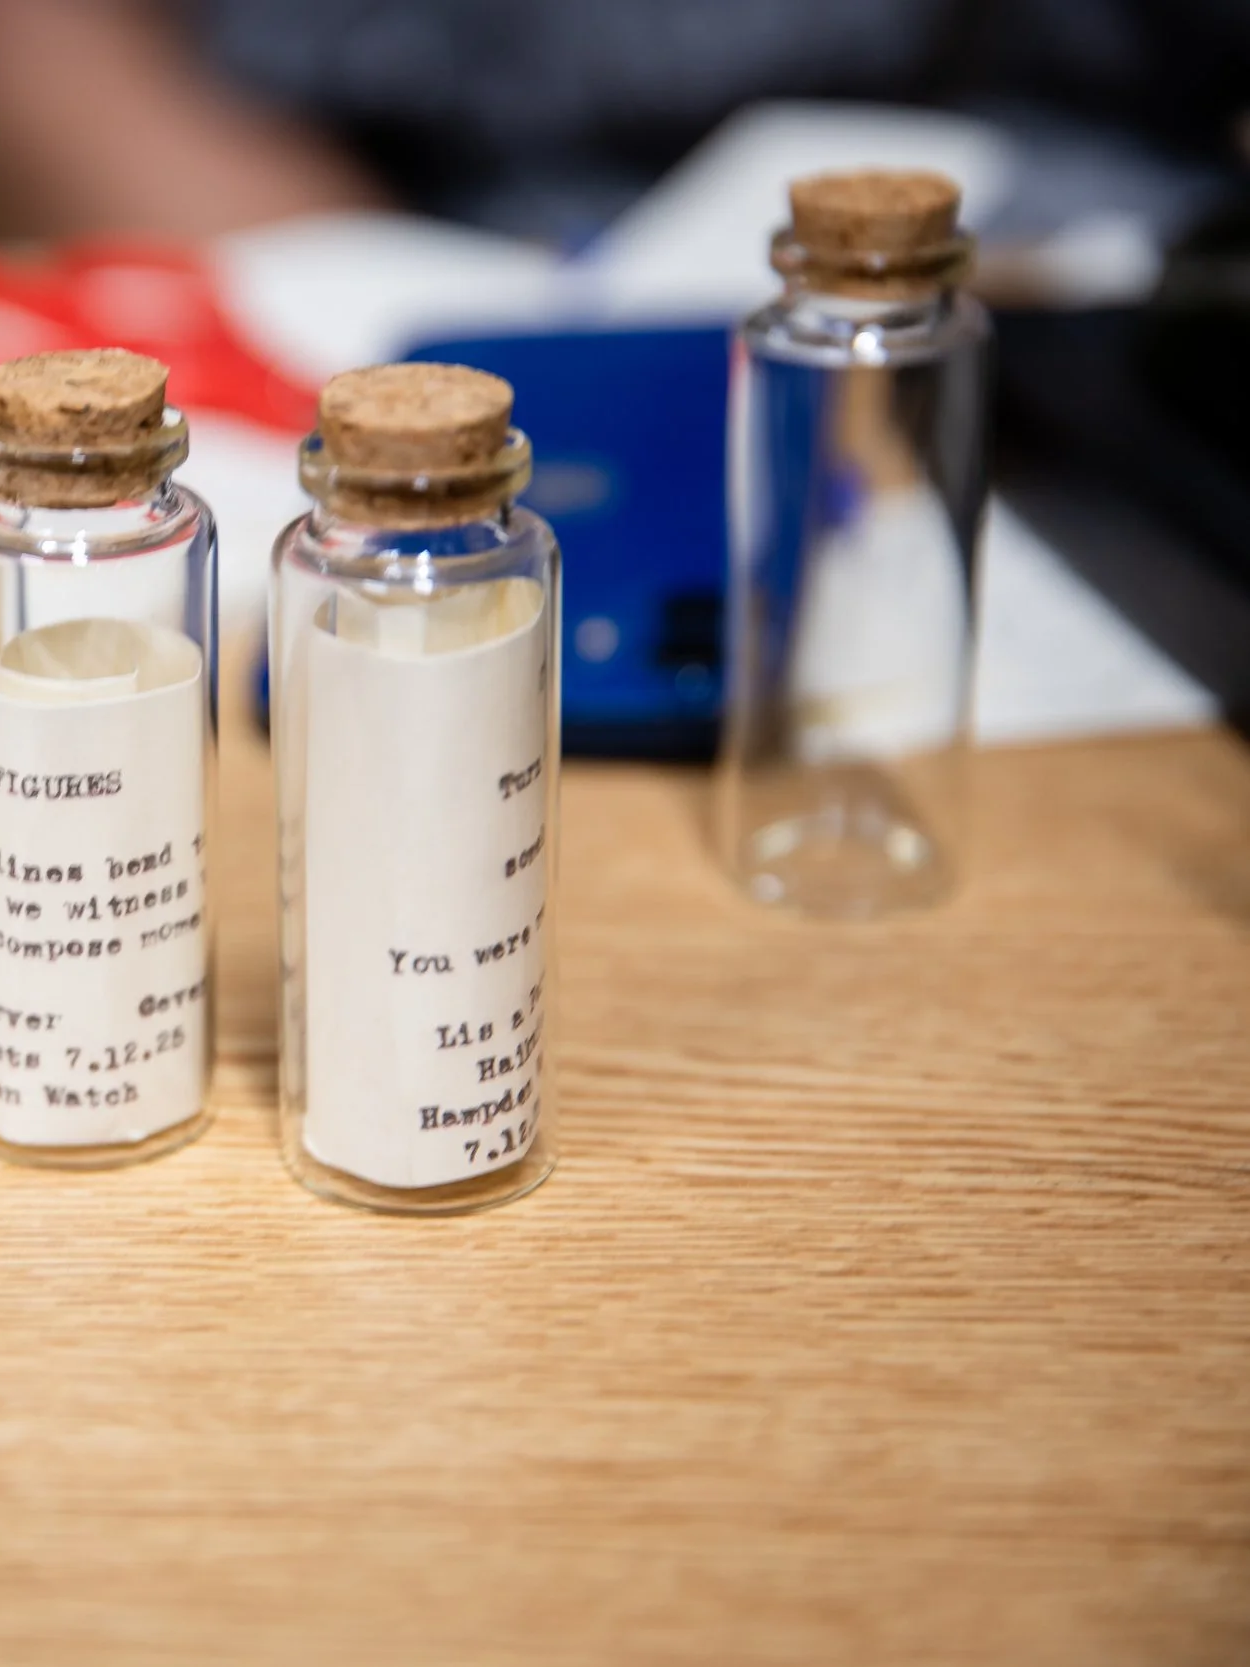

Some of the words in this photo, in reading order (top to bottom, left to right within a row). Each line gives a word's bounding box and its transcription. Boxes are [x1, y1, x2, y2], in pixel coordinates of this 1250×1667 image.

[6, 896, 43, 921] we
[65, 880, 189, 921] witness
[388, 947, 455, 975] You
[473, 925, 530, 967] were
[43, 1081, 139, 1108] Watch
[419, 1077, 533, 1131] Hampde
